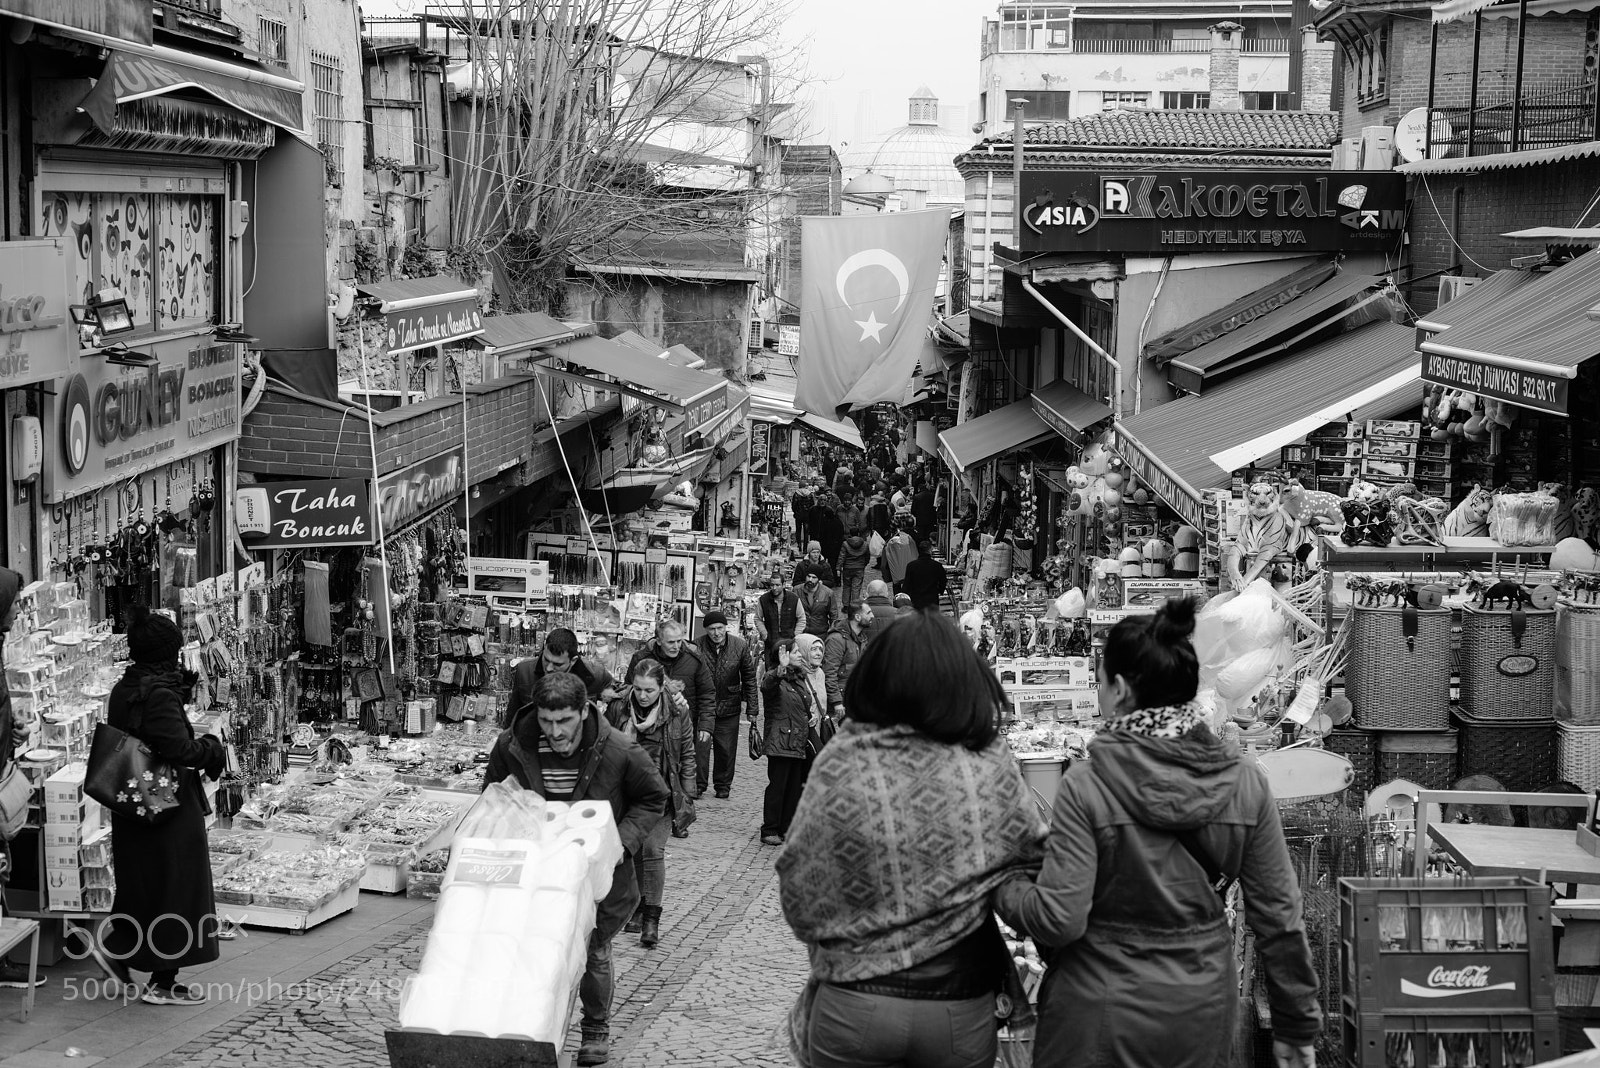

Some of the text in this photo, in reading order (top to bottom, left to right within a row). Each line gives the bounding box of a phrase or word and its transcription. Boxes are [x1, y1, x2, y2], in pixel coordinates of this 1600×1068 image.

[1035, 206, 1087, 226] ASIA
[1259, 230, 1306, 246] EŞYA
[1221, 284, 1302, 332] OYUNCAK
[397, 318, 418, 347] Taha
[417, 314, 441, 341] Boncuk
[188, 375, 235, 404] BONCUK
[1457, 361, 1482, 392] PELUŞ
[1484, 365, 1520, 395] DÜNYASI
[1523, 376, 1536, 399] 522
[1537, 378, 1547, 401] 60
[1547, 380, 1557, 403] 17
[93, 363, 187, 448] GÜNEY
[274, 487, 356, 514] Taha
[273, 515, 365, 538] Boncuk
